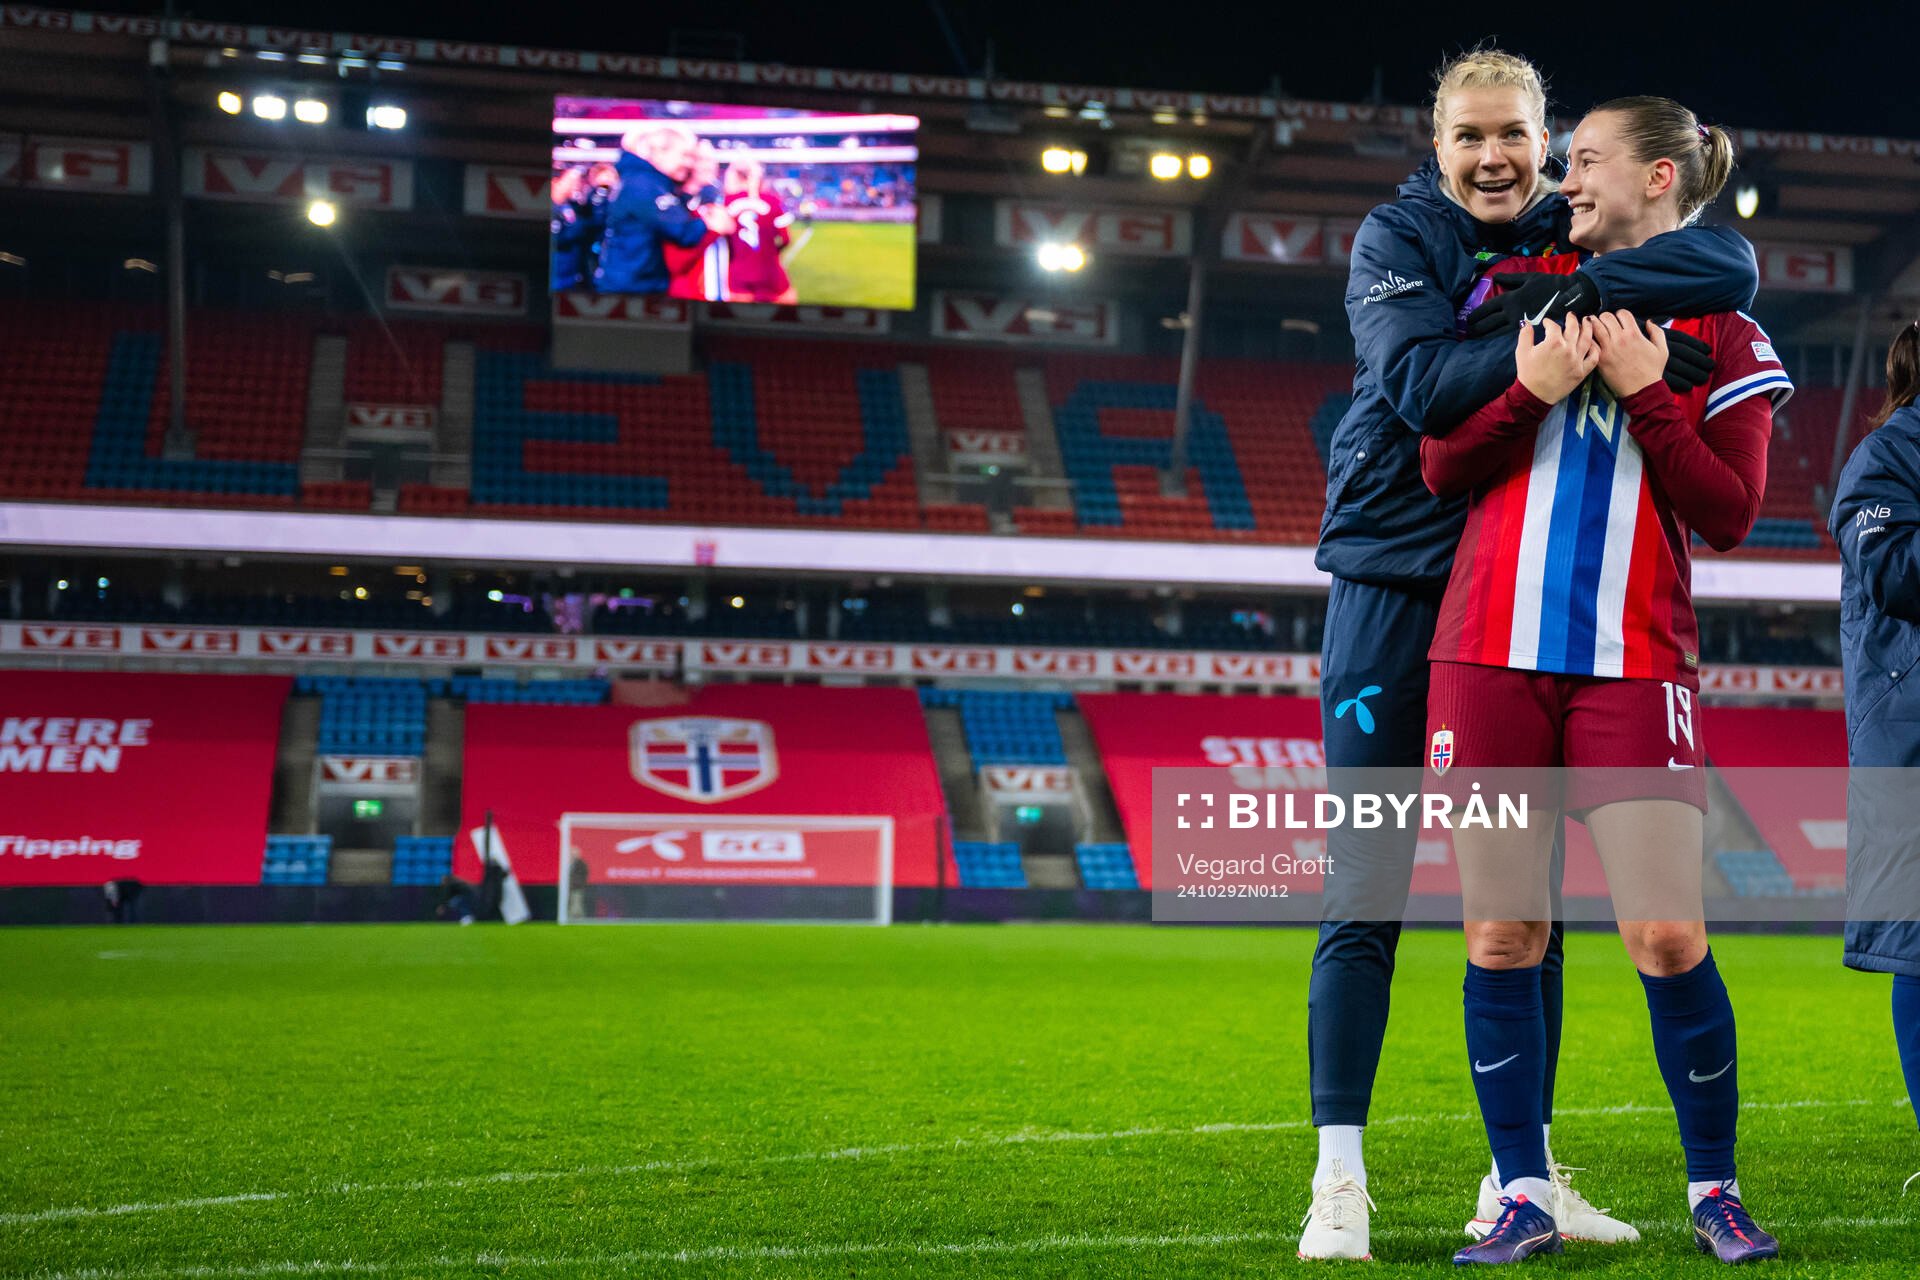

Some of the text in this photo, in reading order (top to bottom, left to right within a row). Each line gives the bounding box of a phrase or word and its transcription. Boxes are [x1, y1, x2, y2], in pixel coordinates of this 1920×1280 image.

[206, 156, 392, 205] VG
[1012, 207, 1172, 250] VG
[392, 270, 523, 306] VG
[945, 297, 1104, 338] VG
[349, 405, 432, 428] VG
[951, 431, 1024, 453] VG
[1856, 504, 1891, 528] DNB
[22, 625, 120, 649] VG
[143, 628, 238, 652] VG
[260, 631, 352, 655] VG
[374, 634, 466, 659] VG
[486, 636, 577, 661] VG
[596, 640, 682, 664] VG
[703, 643, 790, 667] VG
[809, 645, 894, 669] VG
[913, 648, 996, 671] VG
[1013, 651, 1096, 674] VG
[1114, 652, 1195, 675] VG
[1212, 656, 1292, 678] VG
[1661, 681, 1694, 752] 19
[1, 717, 152, 746] KERE
[0, 745, 122, 773] MEN
[322, 757, 414, 782] VG
[988, 768, 1072, 791] VG
[0, 835, 142, 859] Tipping
